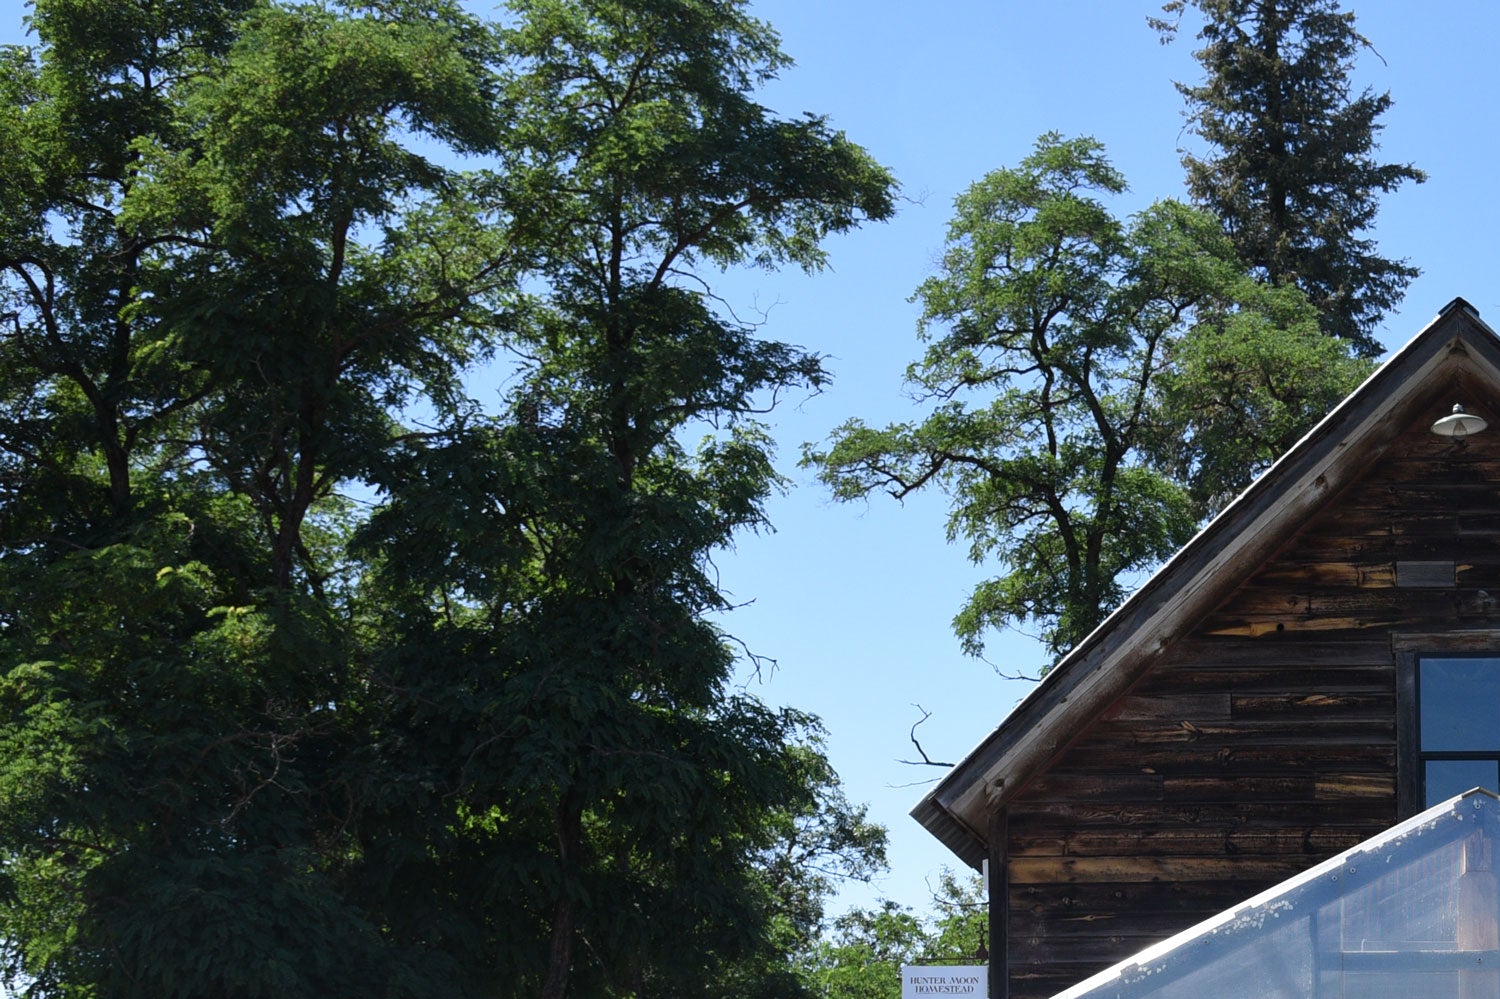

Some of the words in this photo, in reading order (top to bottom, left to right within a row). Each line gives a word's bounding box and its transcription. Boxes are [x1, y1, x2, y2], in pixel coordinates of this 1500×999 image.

[911, 977, 946, 985] HUNTER
[949, 977, 979, 985] MOON
[915, 985, 974, 993] HOMESTEAD
